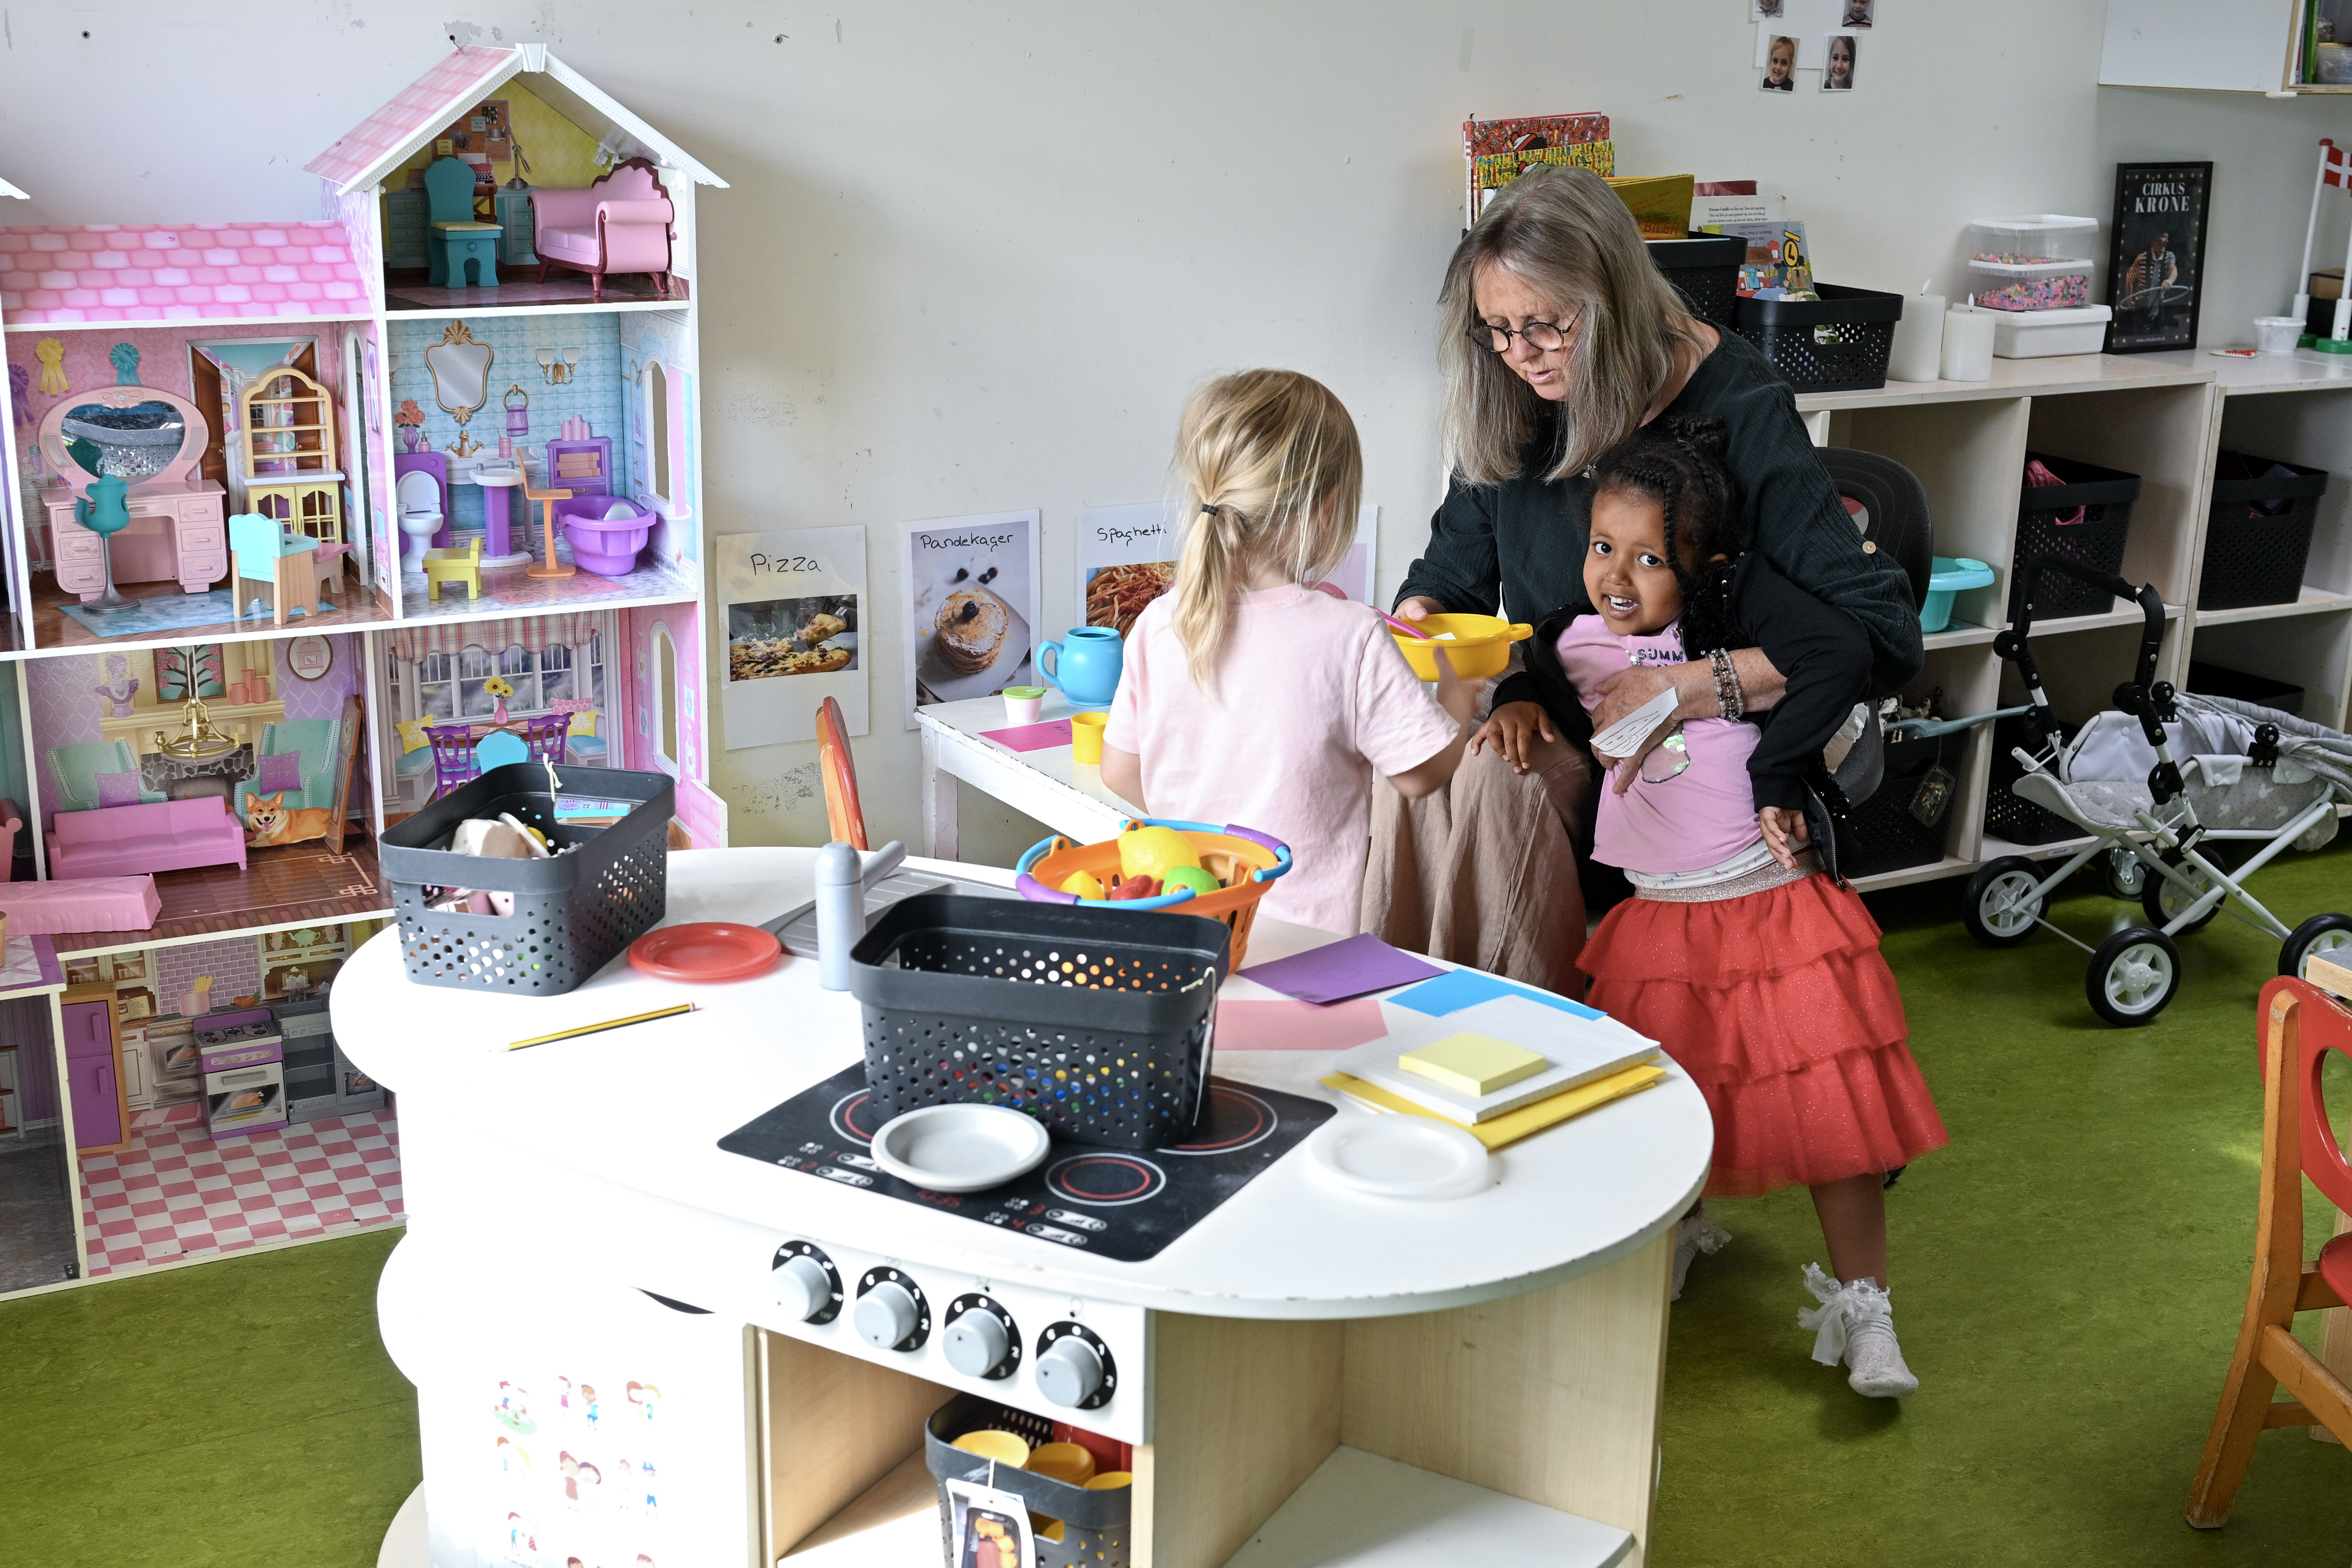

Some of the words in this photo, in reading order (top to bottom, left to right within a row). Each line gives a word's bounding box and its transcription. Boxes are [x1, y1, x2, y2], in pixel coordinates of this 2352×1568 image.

[2142, 182, 2185, 196] CIRKUS
[2135, 196, 2190, 213] KRONE
[1644, 219, 1680, 235] BILER
[1097, 522, 1167, 547] Spaghetti
[920, 533, 1013, 552] Pandekager
[751, 554, 822, 575] Pizza
[913, 1287, 920, 1300] 1
[921, 1318, 929, 1331] 2
[1003, 1315, 1011, 1327] 1
[1011, 1346, 1020, 1359] 2
[1097, 1343, 1105, 1356] 1
[1105, 1375, 1114, 1388] 2
